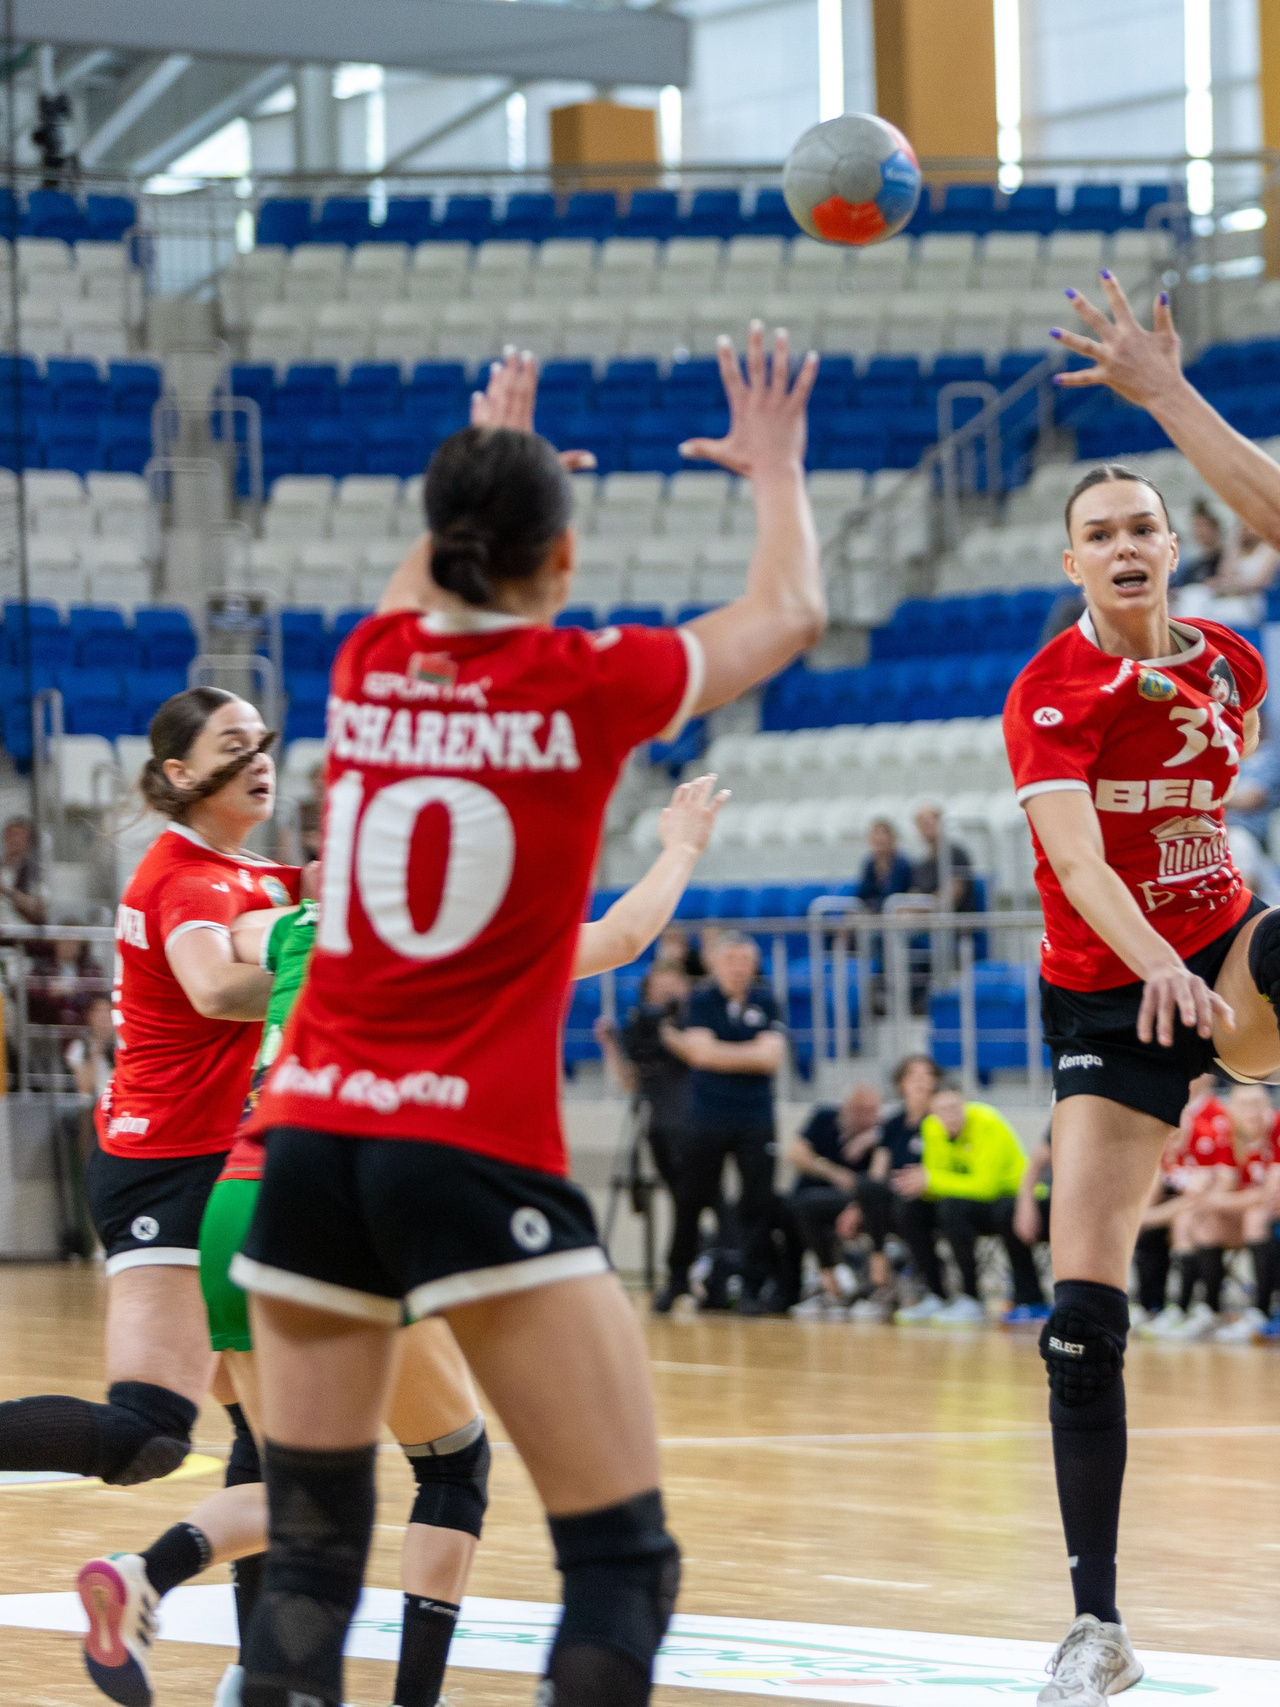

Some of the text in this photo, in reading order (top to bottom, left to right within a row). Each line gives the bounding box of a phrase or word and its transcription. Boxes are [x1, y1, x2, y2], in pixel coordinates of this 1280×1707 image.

[1162, 701, 1241, 768] 34
[317, 768, 517, 963] 10
[1058, 1053, 1104, 1070] Kempa
[1048, 1336, 1085, 1355] SELECT
